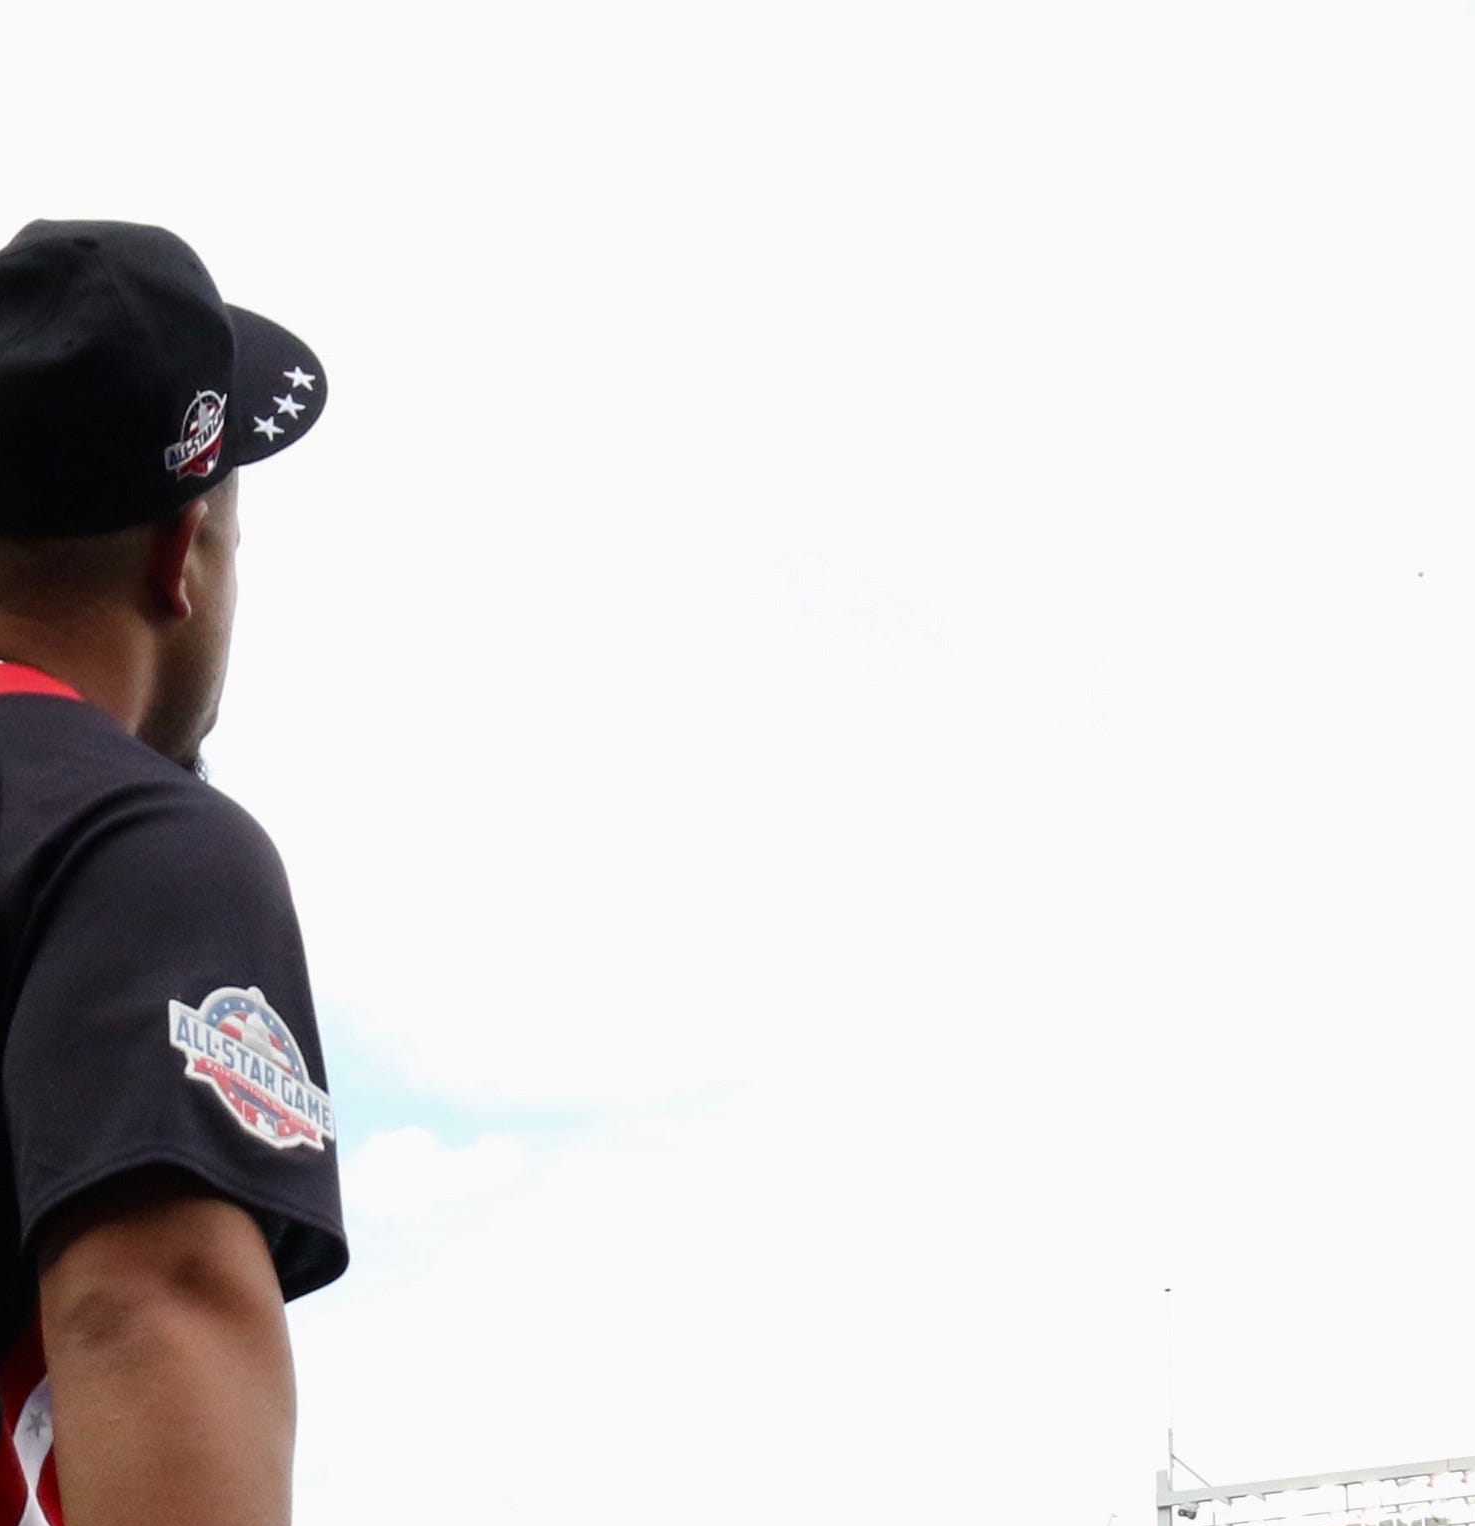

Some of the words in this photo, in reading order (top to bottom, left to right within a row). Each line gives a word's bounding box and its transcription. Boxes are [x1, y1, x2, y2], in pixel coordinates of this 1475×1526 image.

[176, 1014, 217, 1060] ALL
[222, 1038, 277, 1094] STAR
[281, 1076, 335, 1131] GAME
